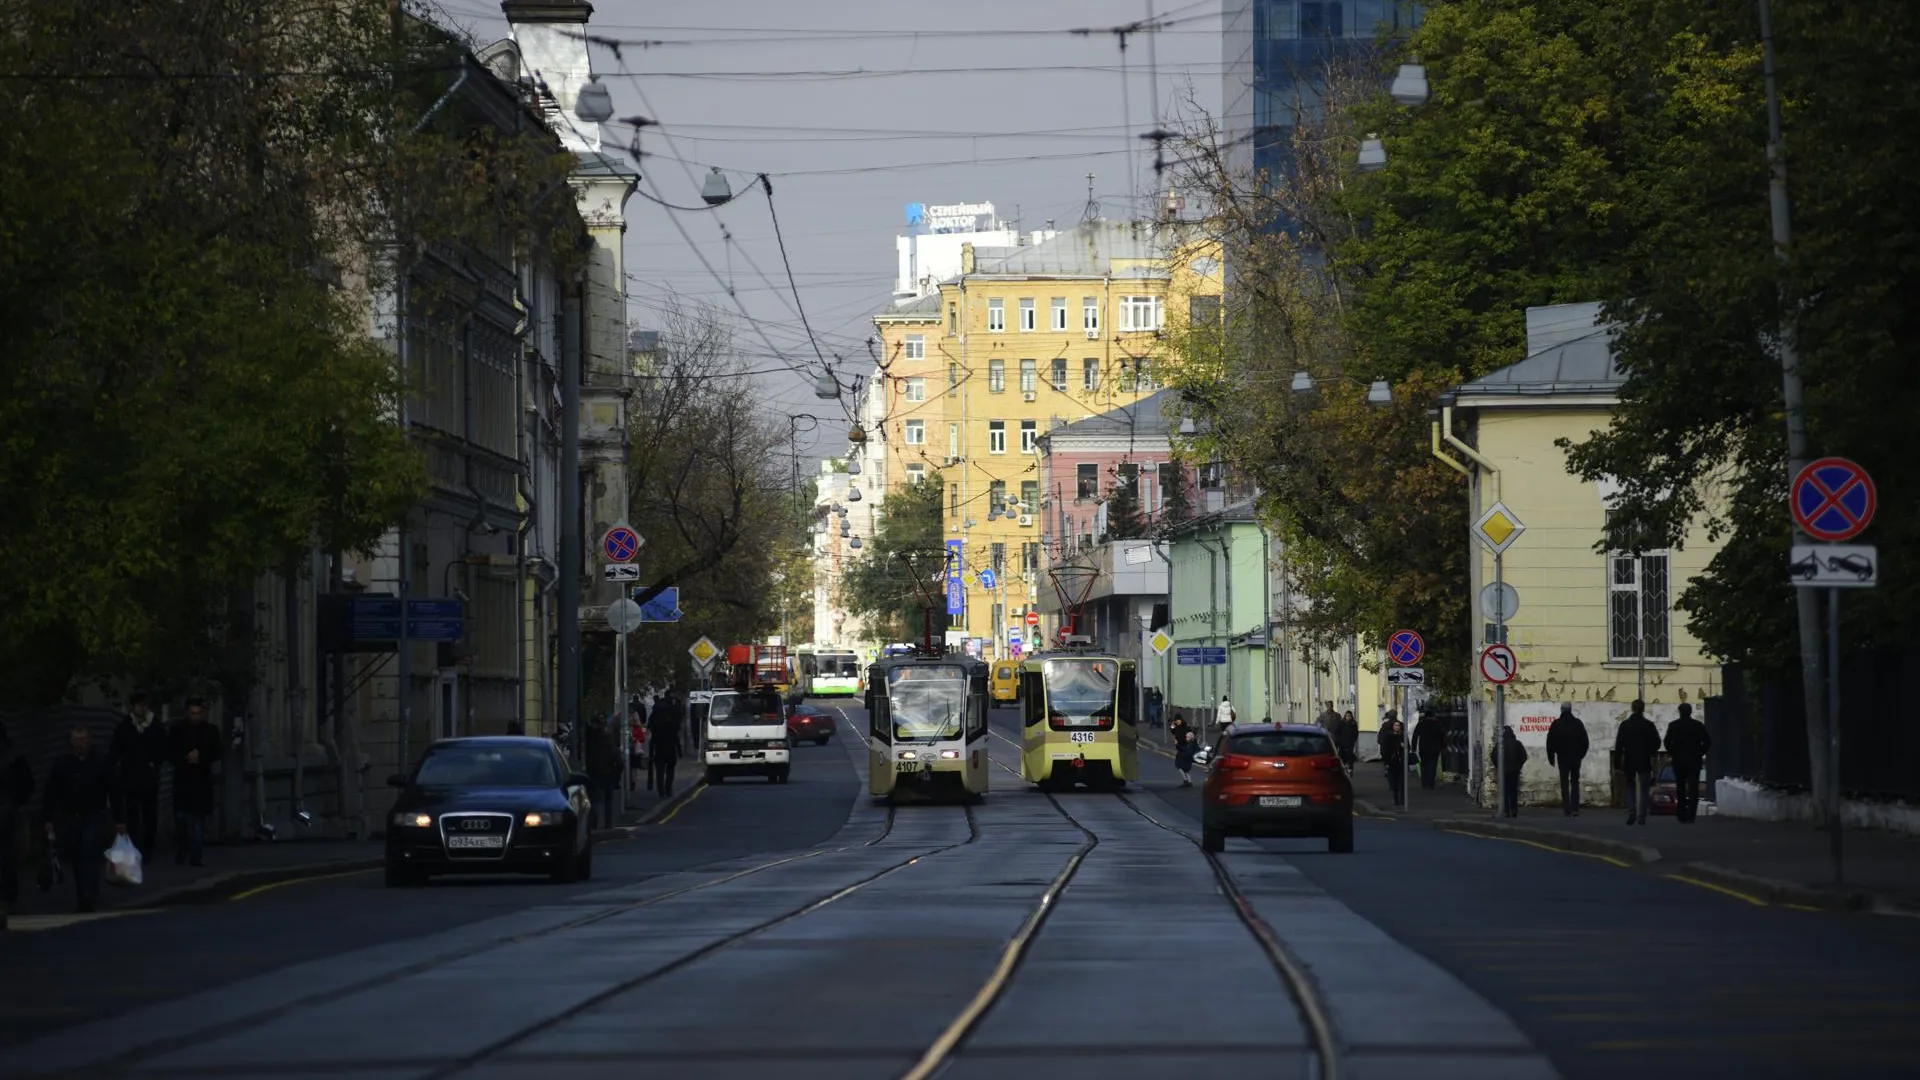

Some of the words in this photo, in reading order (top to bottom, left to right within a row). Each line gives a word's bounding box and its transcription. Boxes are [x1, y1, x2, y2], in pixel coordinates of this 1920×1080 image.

[929, 215, 976, 229] ДОКТОР
[1071, 733, 1094, 741] 4316
[896, 761, 918, 772] 4107
